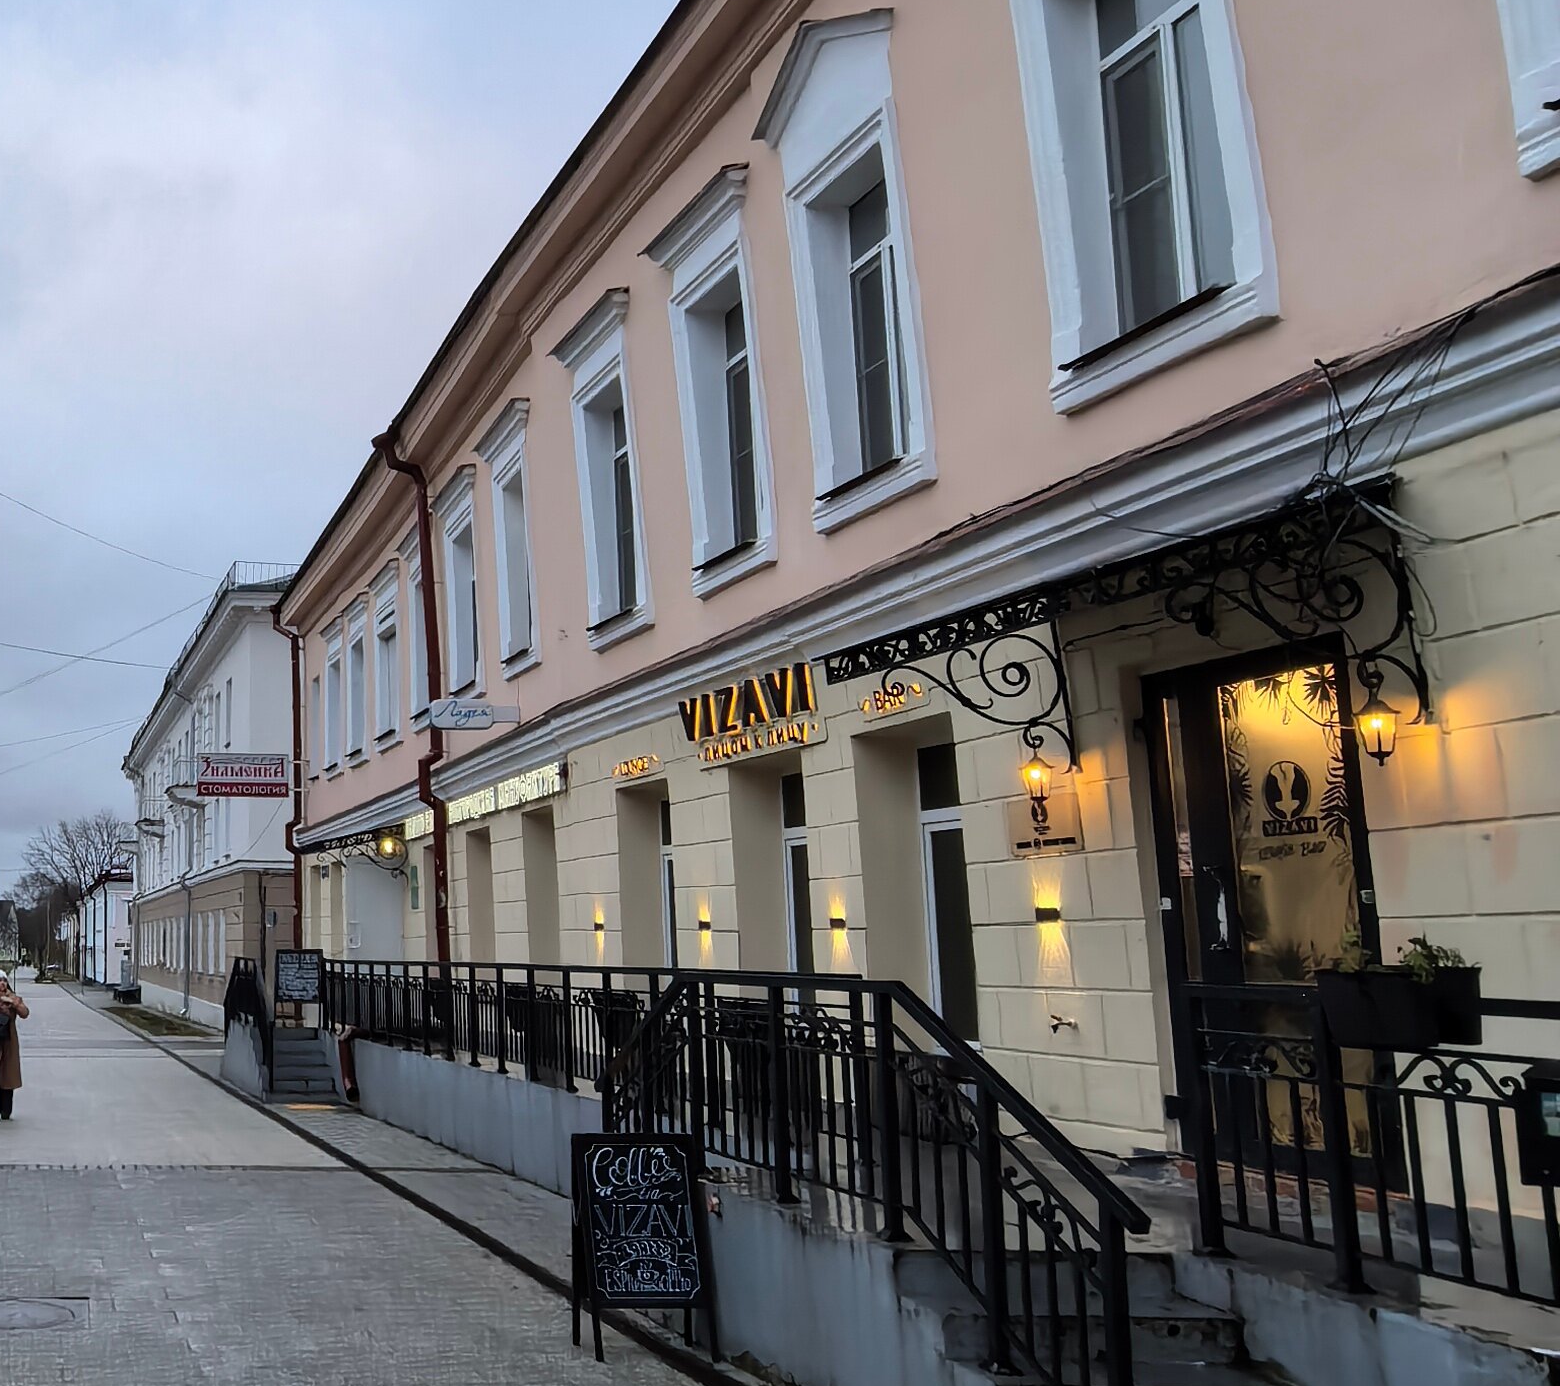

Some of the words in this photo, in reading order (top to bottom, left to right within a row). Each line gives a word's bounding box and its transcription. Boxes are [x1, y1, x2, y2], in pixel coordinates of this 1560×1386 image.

[678, 662, 816, 743] VIZAVI
[201, 784, 287, 794] СТОМАТОЛОГИЯ
[1264, 818, 1316, 834] VIZAVI
[594, 1204, 694, 1237] VIZAVI
